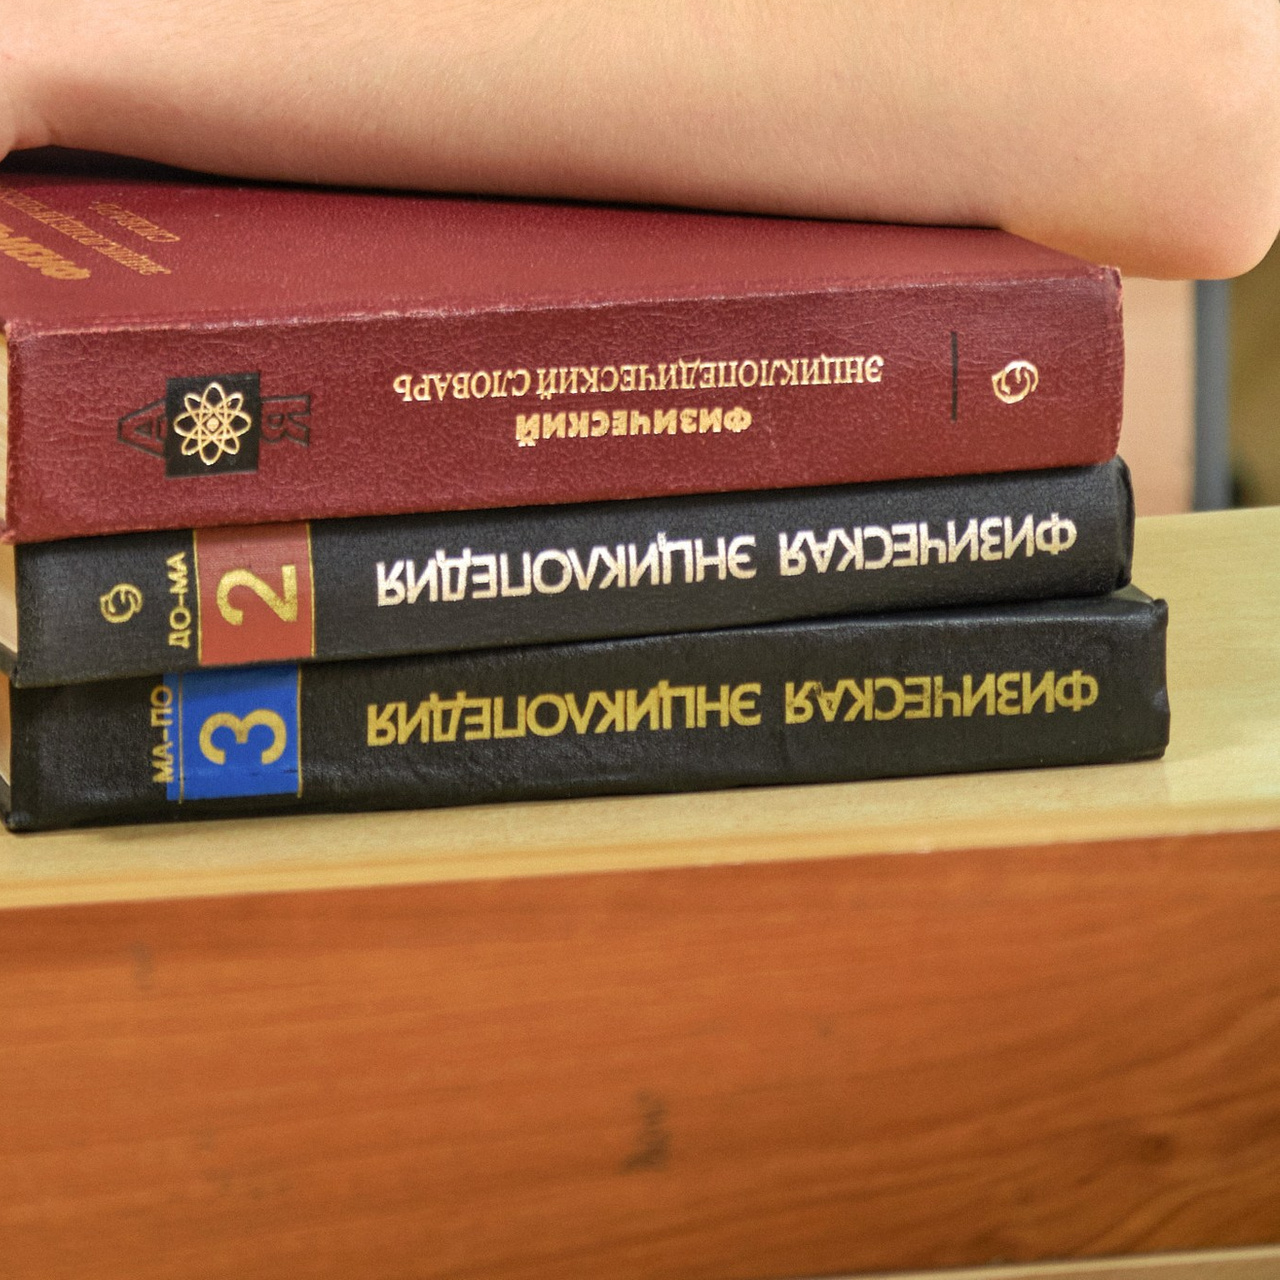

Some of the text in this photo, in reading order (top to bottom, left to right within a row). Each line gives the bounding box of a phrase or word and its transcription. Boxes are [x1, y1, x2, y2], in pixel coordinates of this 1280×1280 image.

[392, 354, 884, 402] ЭНЦИКЛОПЕДИЧЕСКИЙ СЛОВАРЬ
[514, 406, 752, 447] ФИЗИЧЕСКИЙ
[375, 512, 1077, 607] ФИЗИЧЕСКАЯ ЭНЦИКЛОПЕДИЯ
[216, 563, 299, 626] 2
[199, 708, 287, 766] 3
[366, 669, 1099, 747] ФИЗИЧЕСКАЯ ЭНЦИКЛОПЕДИЯ
